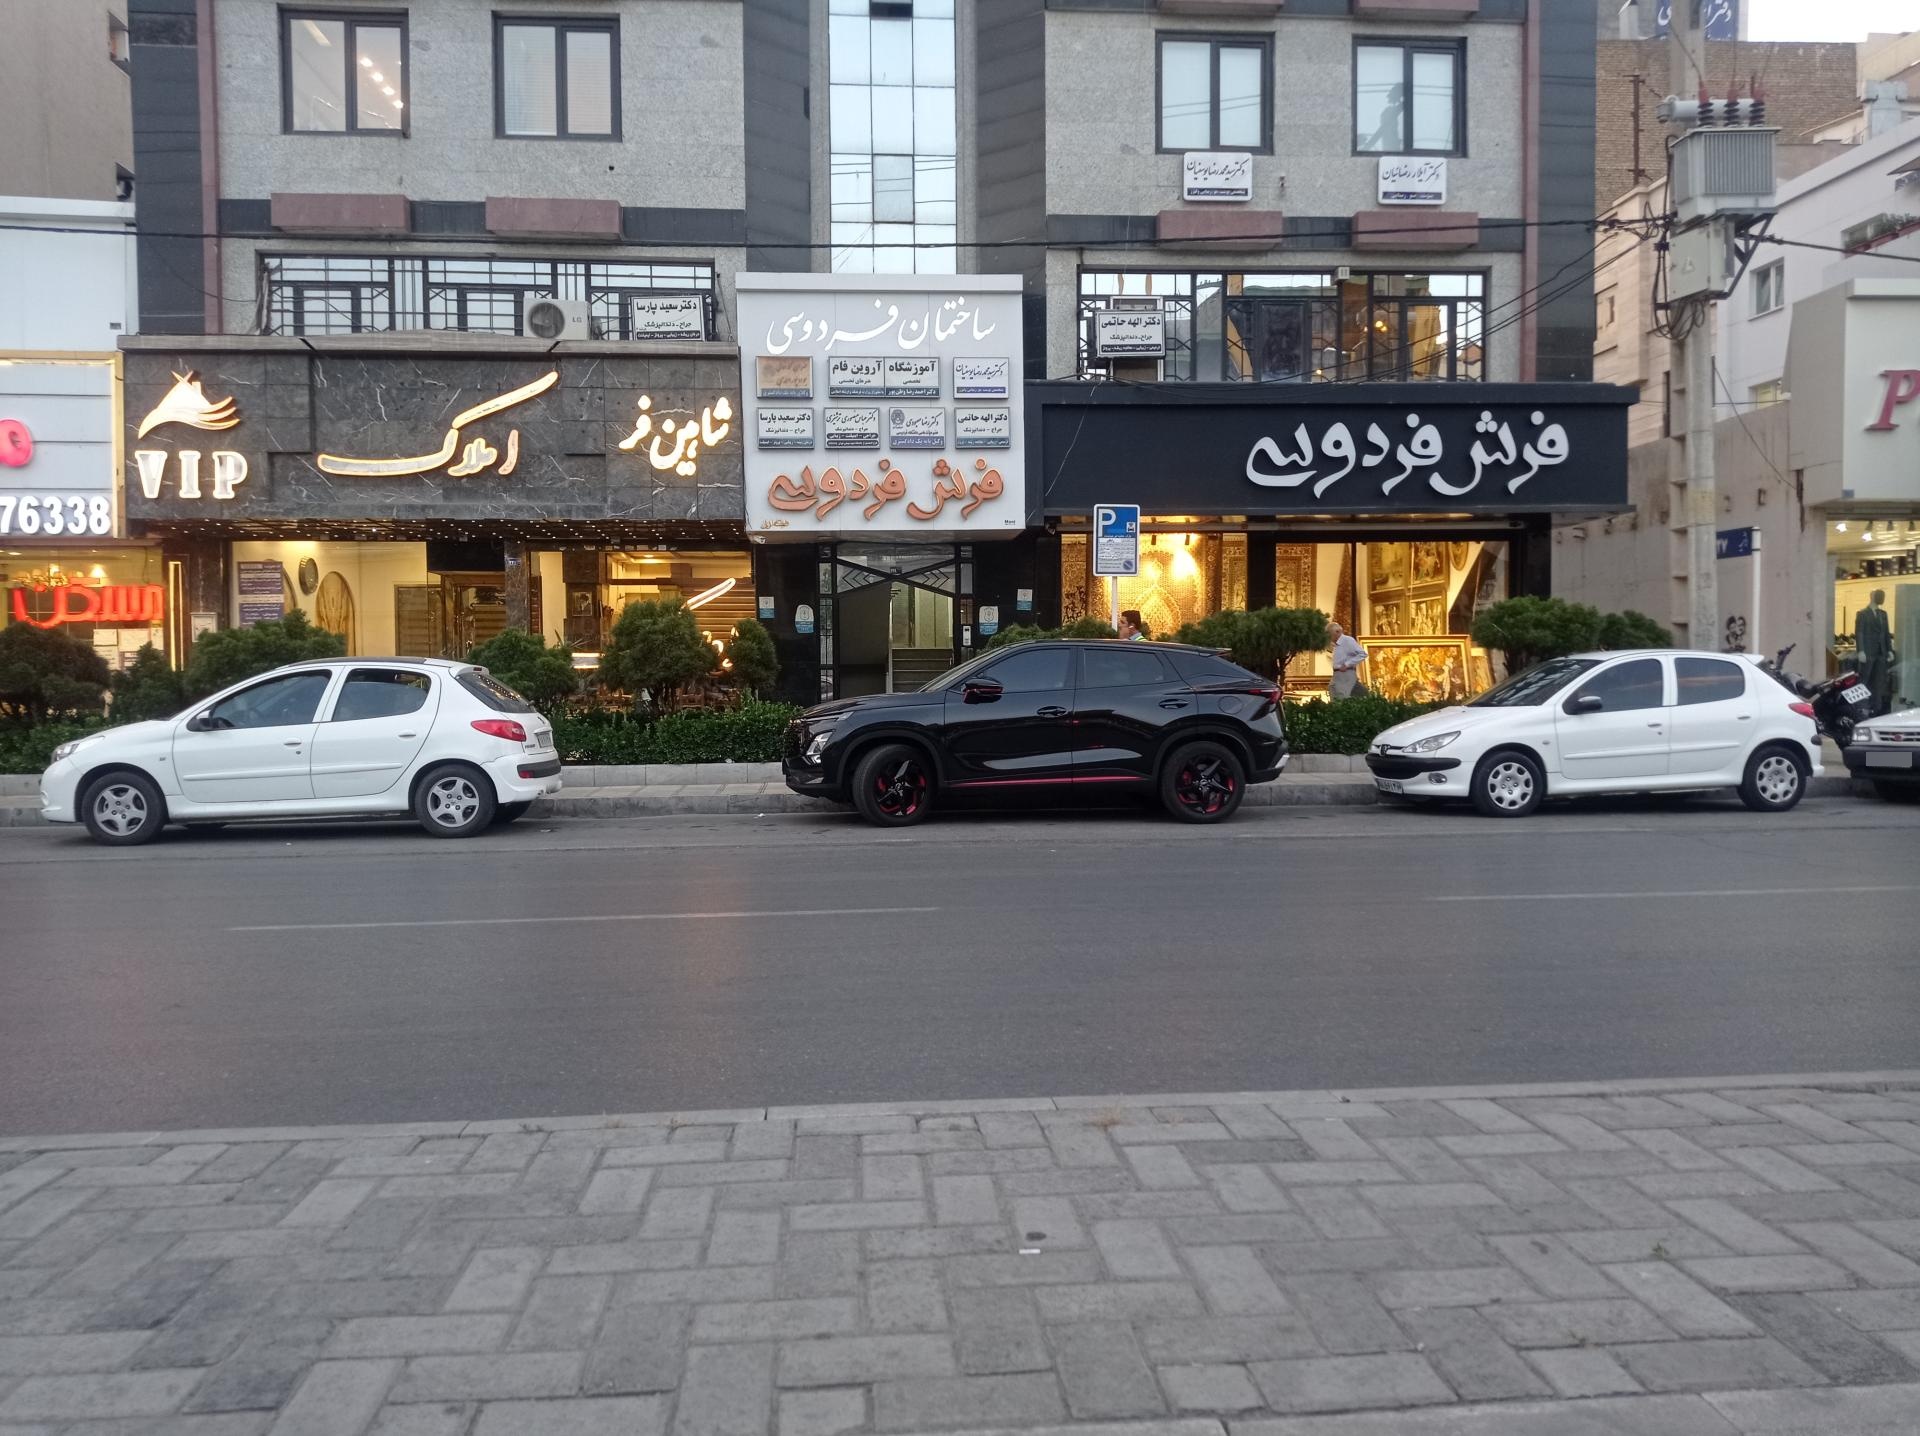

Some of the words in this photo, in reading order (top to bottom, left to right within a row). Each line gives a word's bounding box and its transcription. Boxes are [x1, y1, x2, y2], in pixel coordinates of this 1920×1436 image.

[1187, 161, 1208, 181] یوسفیان
[1231, 158, 1250, 178] دکتر
[1426, 162, 1444, 182] دکتر
[636, 301, 657, 315] پارسا
[660, 302, 678, 313] سعید
[677, 300, 697, 313] دکتر
[644, 321, 675, 329] دندانپزشک
[679, 321, 692, 329] جراح
[766, 298, 899, 355] فردوسی
[898, 296, 996, 350] ساختمان
[1101, 316, 1126, 328] حاتمی
[1127, 317, 1142, 328] الهه
[1143, 316, 1161, 328] دکتر
[1110, 334, 1138, 342] دندانپزشک
[832, 360, 848, 374] فام
[851, 360, 882, 375] آروین
[888, 360, 936, 375] آموزشگاه
[991, 361, 1007, 377] دکتر
[316, 369, 560, 478] املاک
[618, 394, 652, 450] فر
[760, 412, 776, 424] پارسا
[778, 414, 795, 423] سعید
[795, 413, 811, 423] دکتر
[866, 409, 878, 423] دکتر
[928, 411, 943, 428] دکتر
[957, 413, 980, 424] حاتمی
[980, 413, 993, 423] الهه
[993, 413, 1008, 423] دکتر
[649, 396, 733, 477] شاهین
[1245, 412, 1444, 499] فردوسی
[1428, 410, 1570, 497] فرش
[134, 450, 249, 499] VIP
[767, 458, 907, 522] فردوسی
[905, 458, 1005, 521] فرش
[0, 495, 111, 535] 76338
[1098, 508, 1117, 538] P
